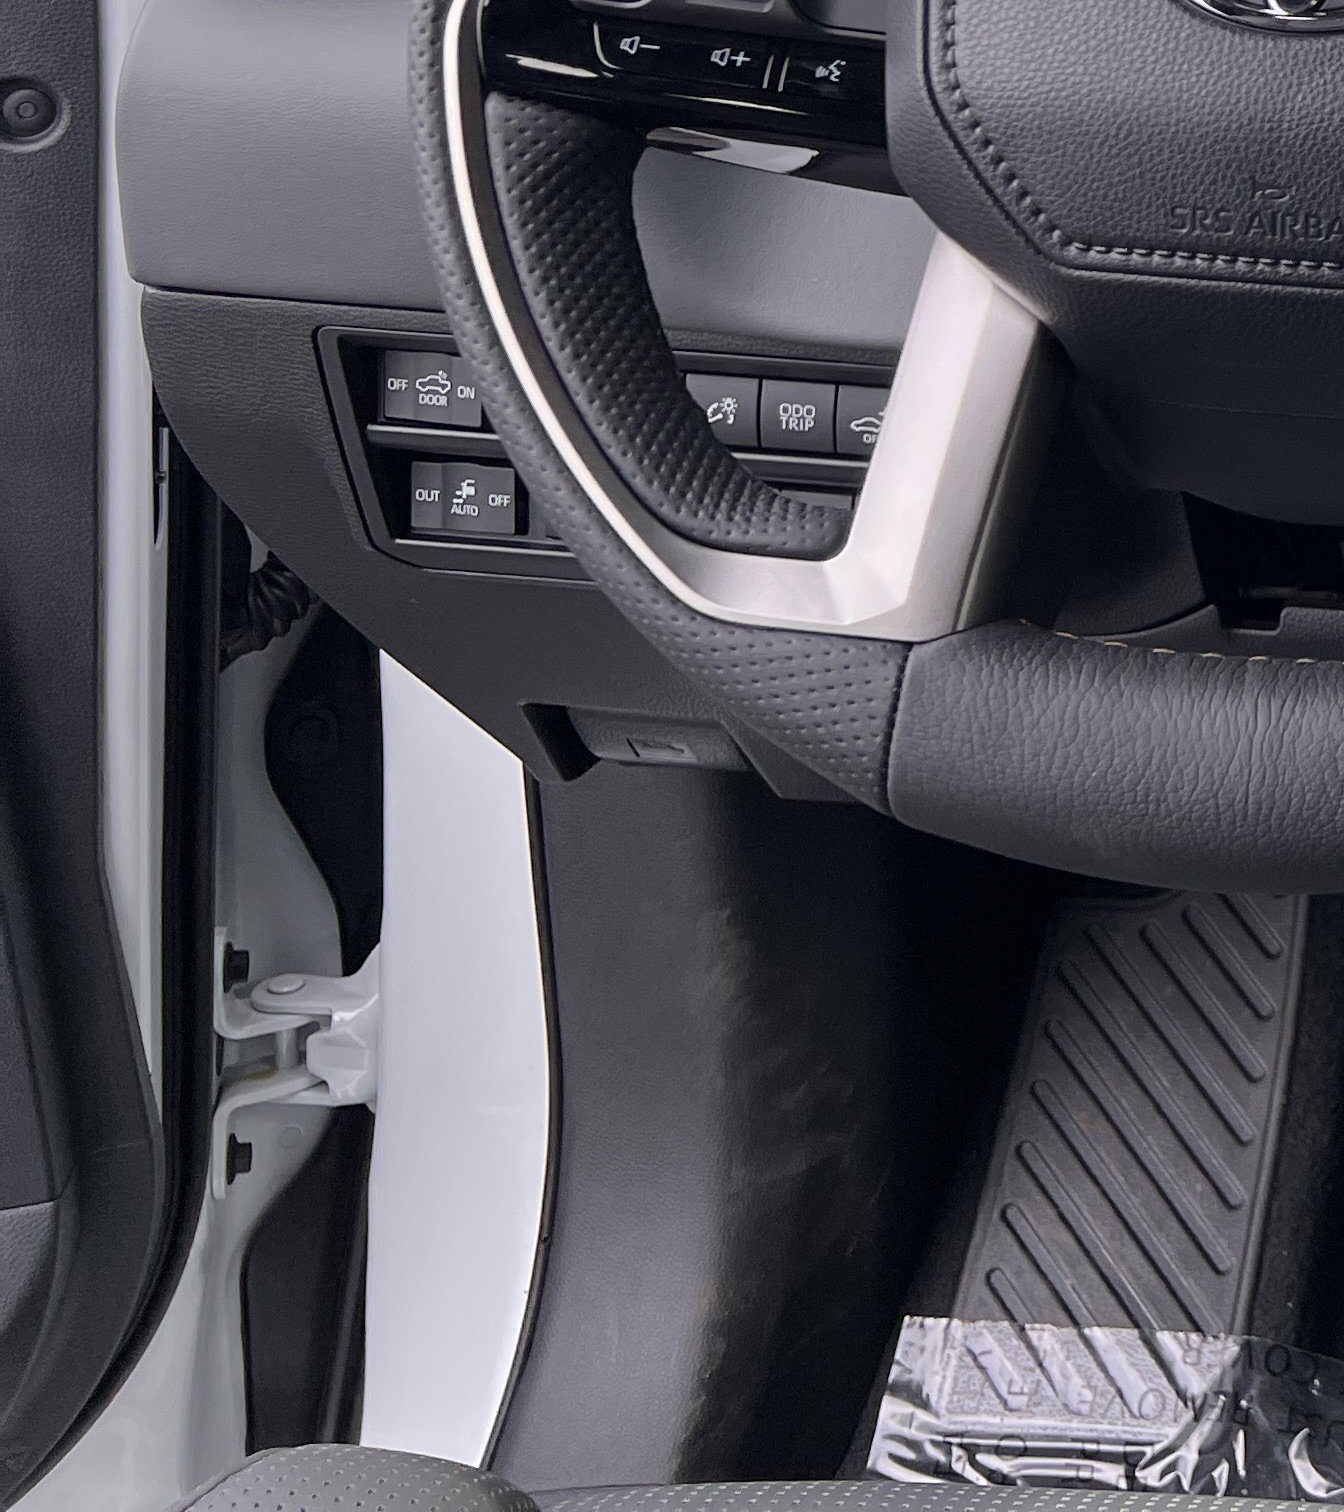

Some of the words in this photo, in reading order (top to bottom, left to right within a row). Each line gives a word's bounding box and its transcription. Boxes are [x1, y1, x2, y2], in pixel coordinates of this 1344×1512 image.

[1170, 205, 1235, 236] SRS
[387, 377, 409, 391] OFF
[457, 385, 476, 399] ON
[418, 394, 448, 407] DOOR
[779, 402, 816, 419] ODO
[779, 416, 815, 432] TRIP
[415, 489, 441, 502] OUT
[488, 494, 511, 507] OFF
[450, 504, 480, 517] AUTO
